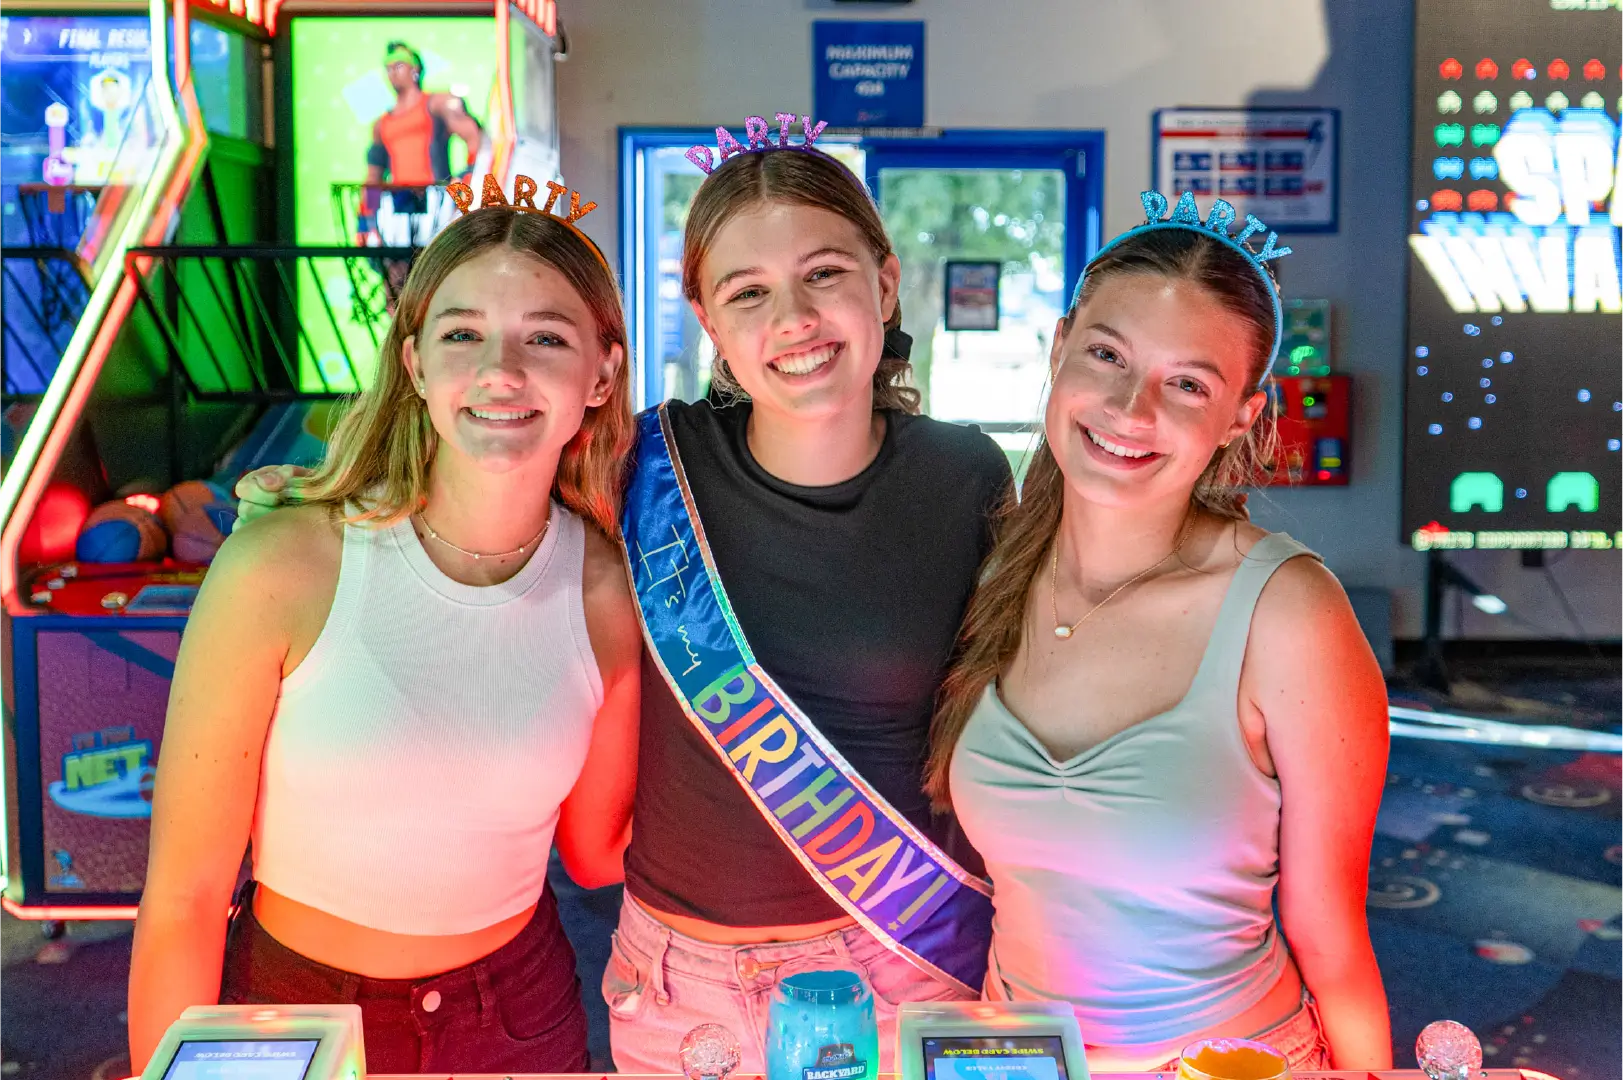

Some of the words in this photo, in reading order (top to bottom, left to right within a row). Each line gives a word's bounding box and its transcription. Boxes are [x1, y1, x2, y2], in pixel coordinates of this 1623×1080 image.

[826, 44, 914, 60] MAXIMUM
[829, 62, 910, 79] CAPACITY
[684, 112, 829, 175] PARTY
[445, 173, 598, 225] PARTY
[1140, 190, 1293, 263] PARTY
[64, 743, 148, 792] NET
[691, 663, 949, 932] BIRTHDAY!
[807, 1066, 864, 1080] BACKYARD
[943, 1048, 980, 1056] BELOW
